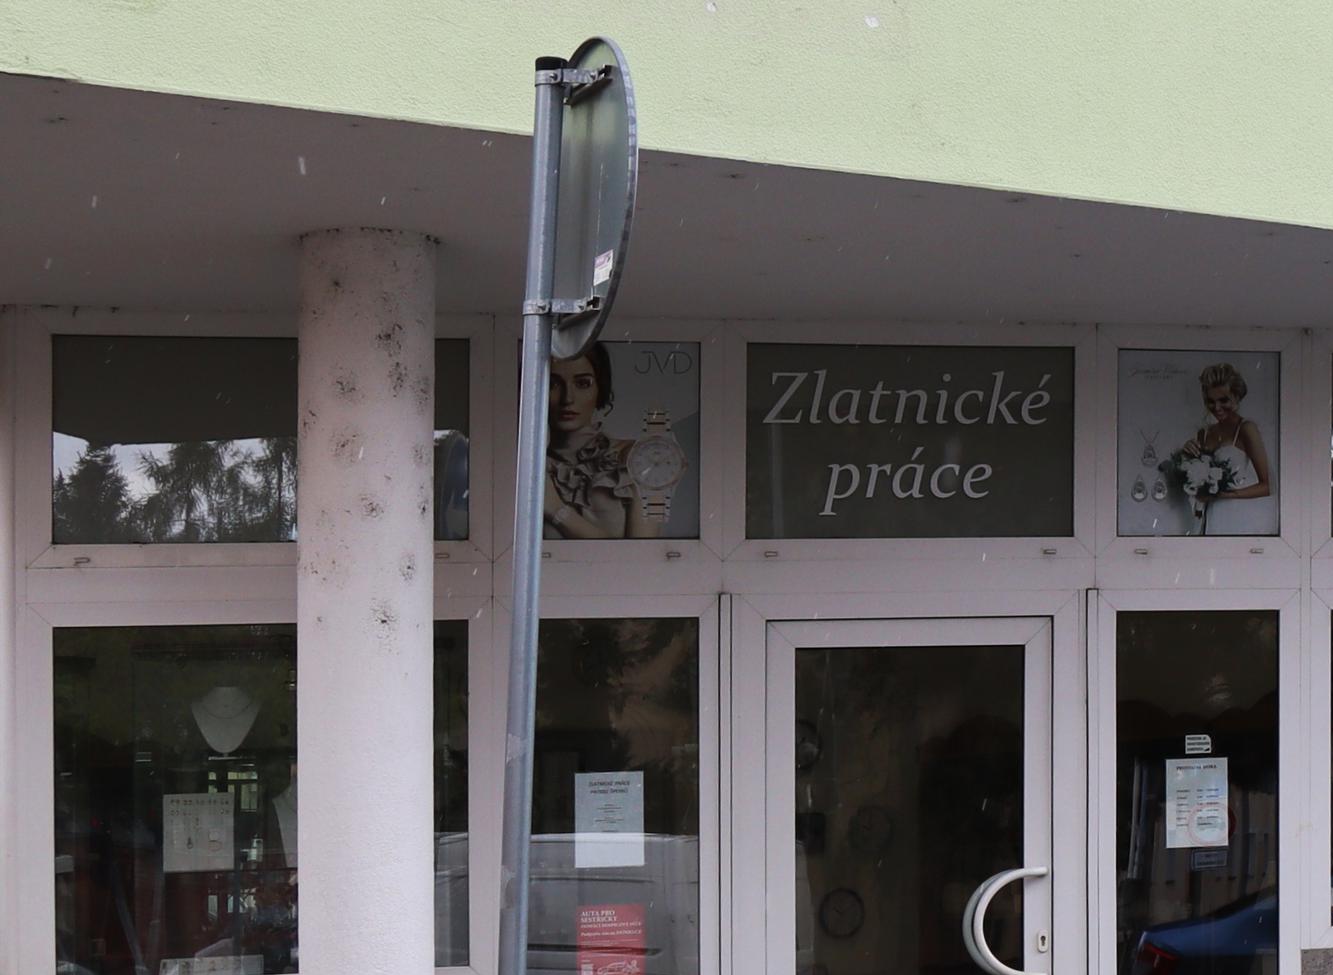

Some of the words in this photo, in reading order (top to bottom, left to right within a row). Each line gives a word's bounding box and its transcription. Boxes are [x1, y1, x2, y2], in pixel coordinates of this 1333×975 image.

[634, 351, 693, 375] JVD
[762, 370, 1050, 426] Zlatnické
[819, 446, 993, 516] práce
